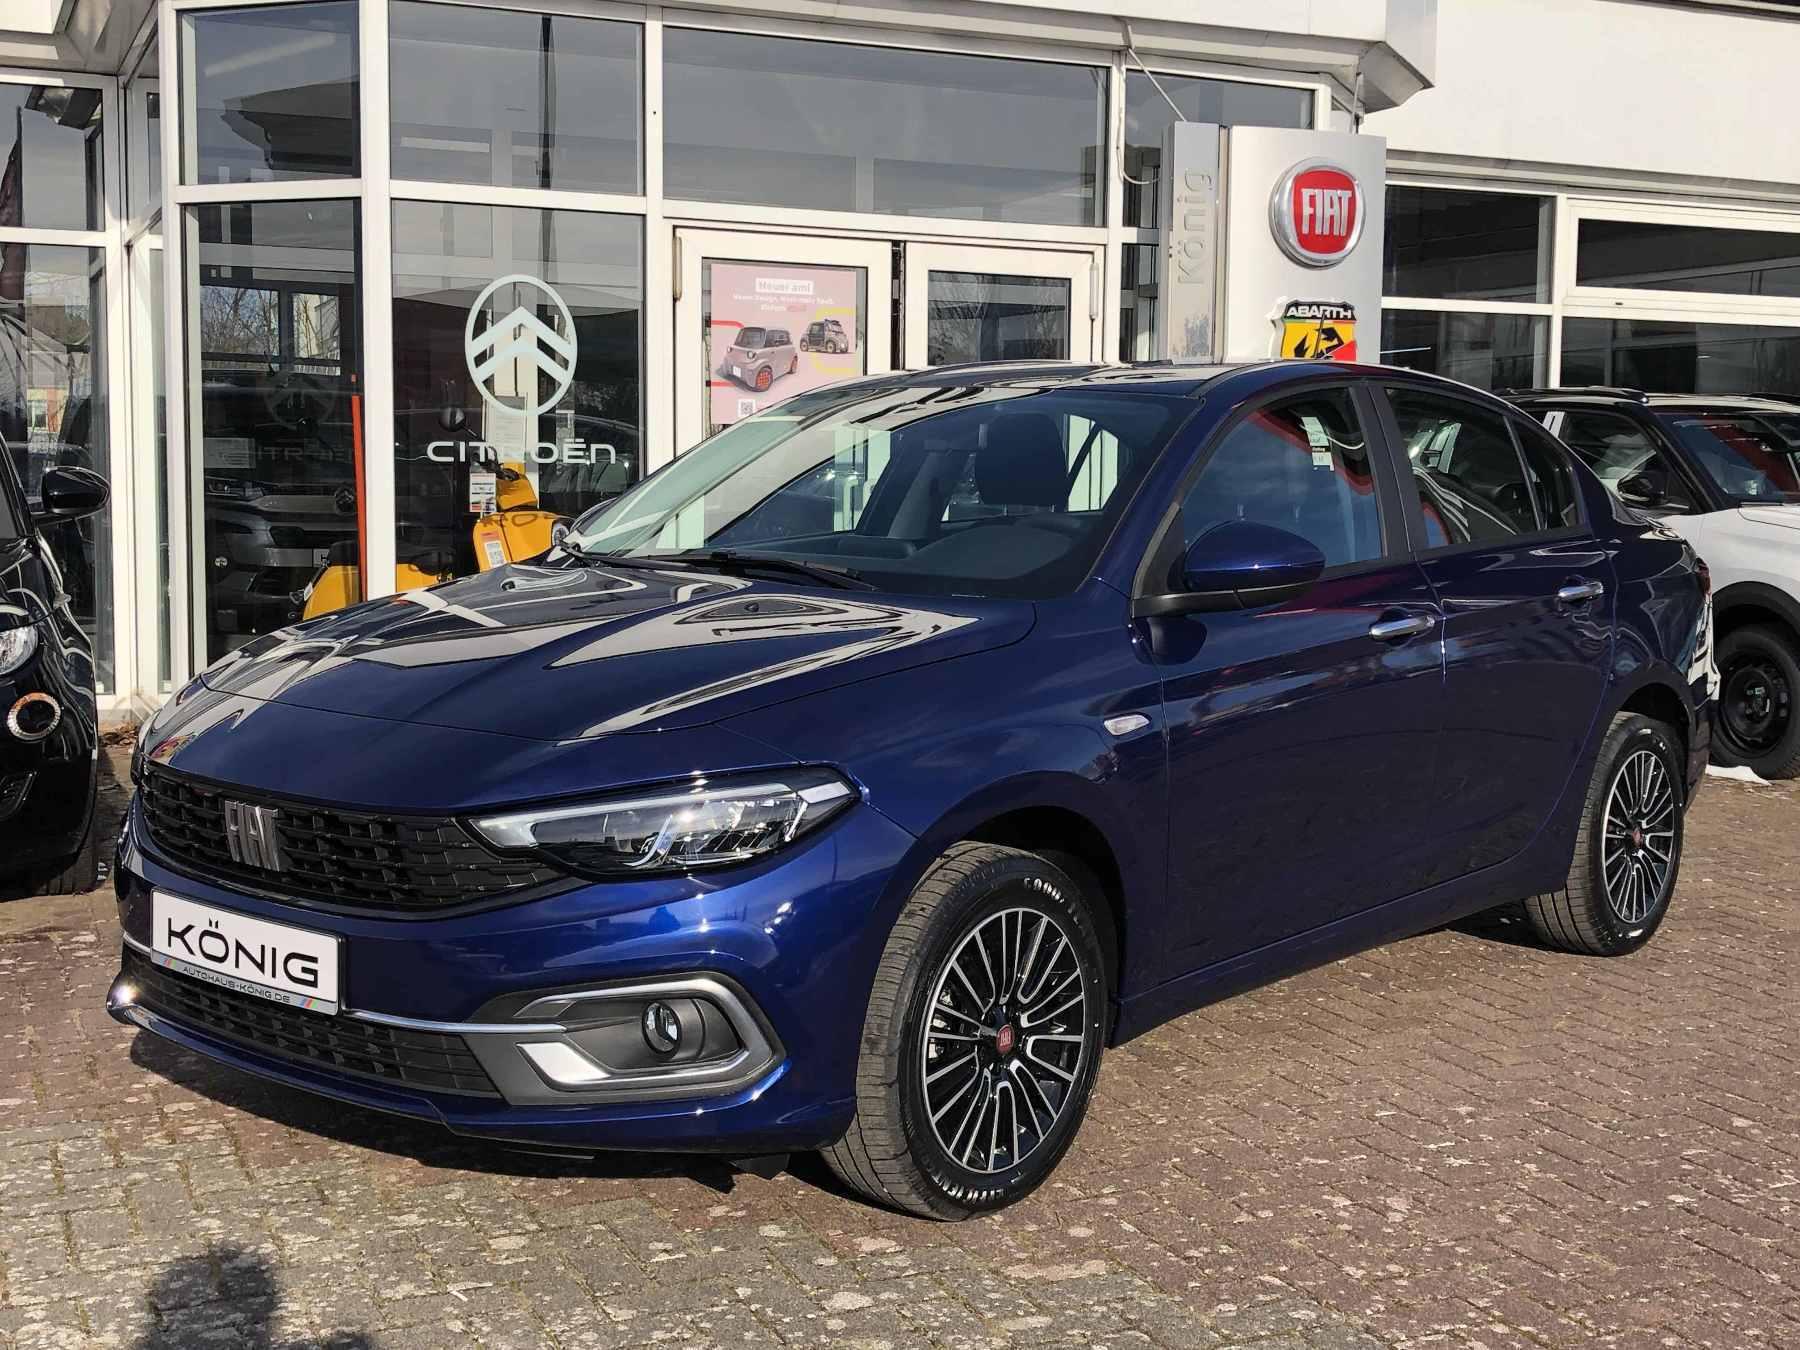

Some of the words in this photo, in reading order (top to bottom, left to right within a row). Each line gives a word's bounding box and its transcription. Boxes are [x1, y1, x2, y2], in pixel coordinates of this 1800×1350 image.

[1177, 168, 1212, 284] König
[1301, 188, 1353, 237] FIAT
[1286, 304, 1352, 319] ABARTH
[224, 800, 280, 872] FIAT
[168, 917, 319, 989] KÖNIG
